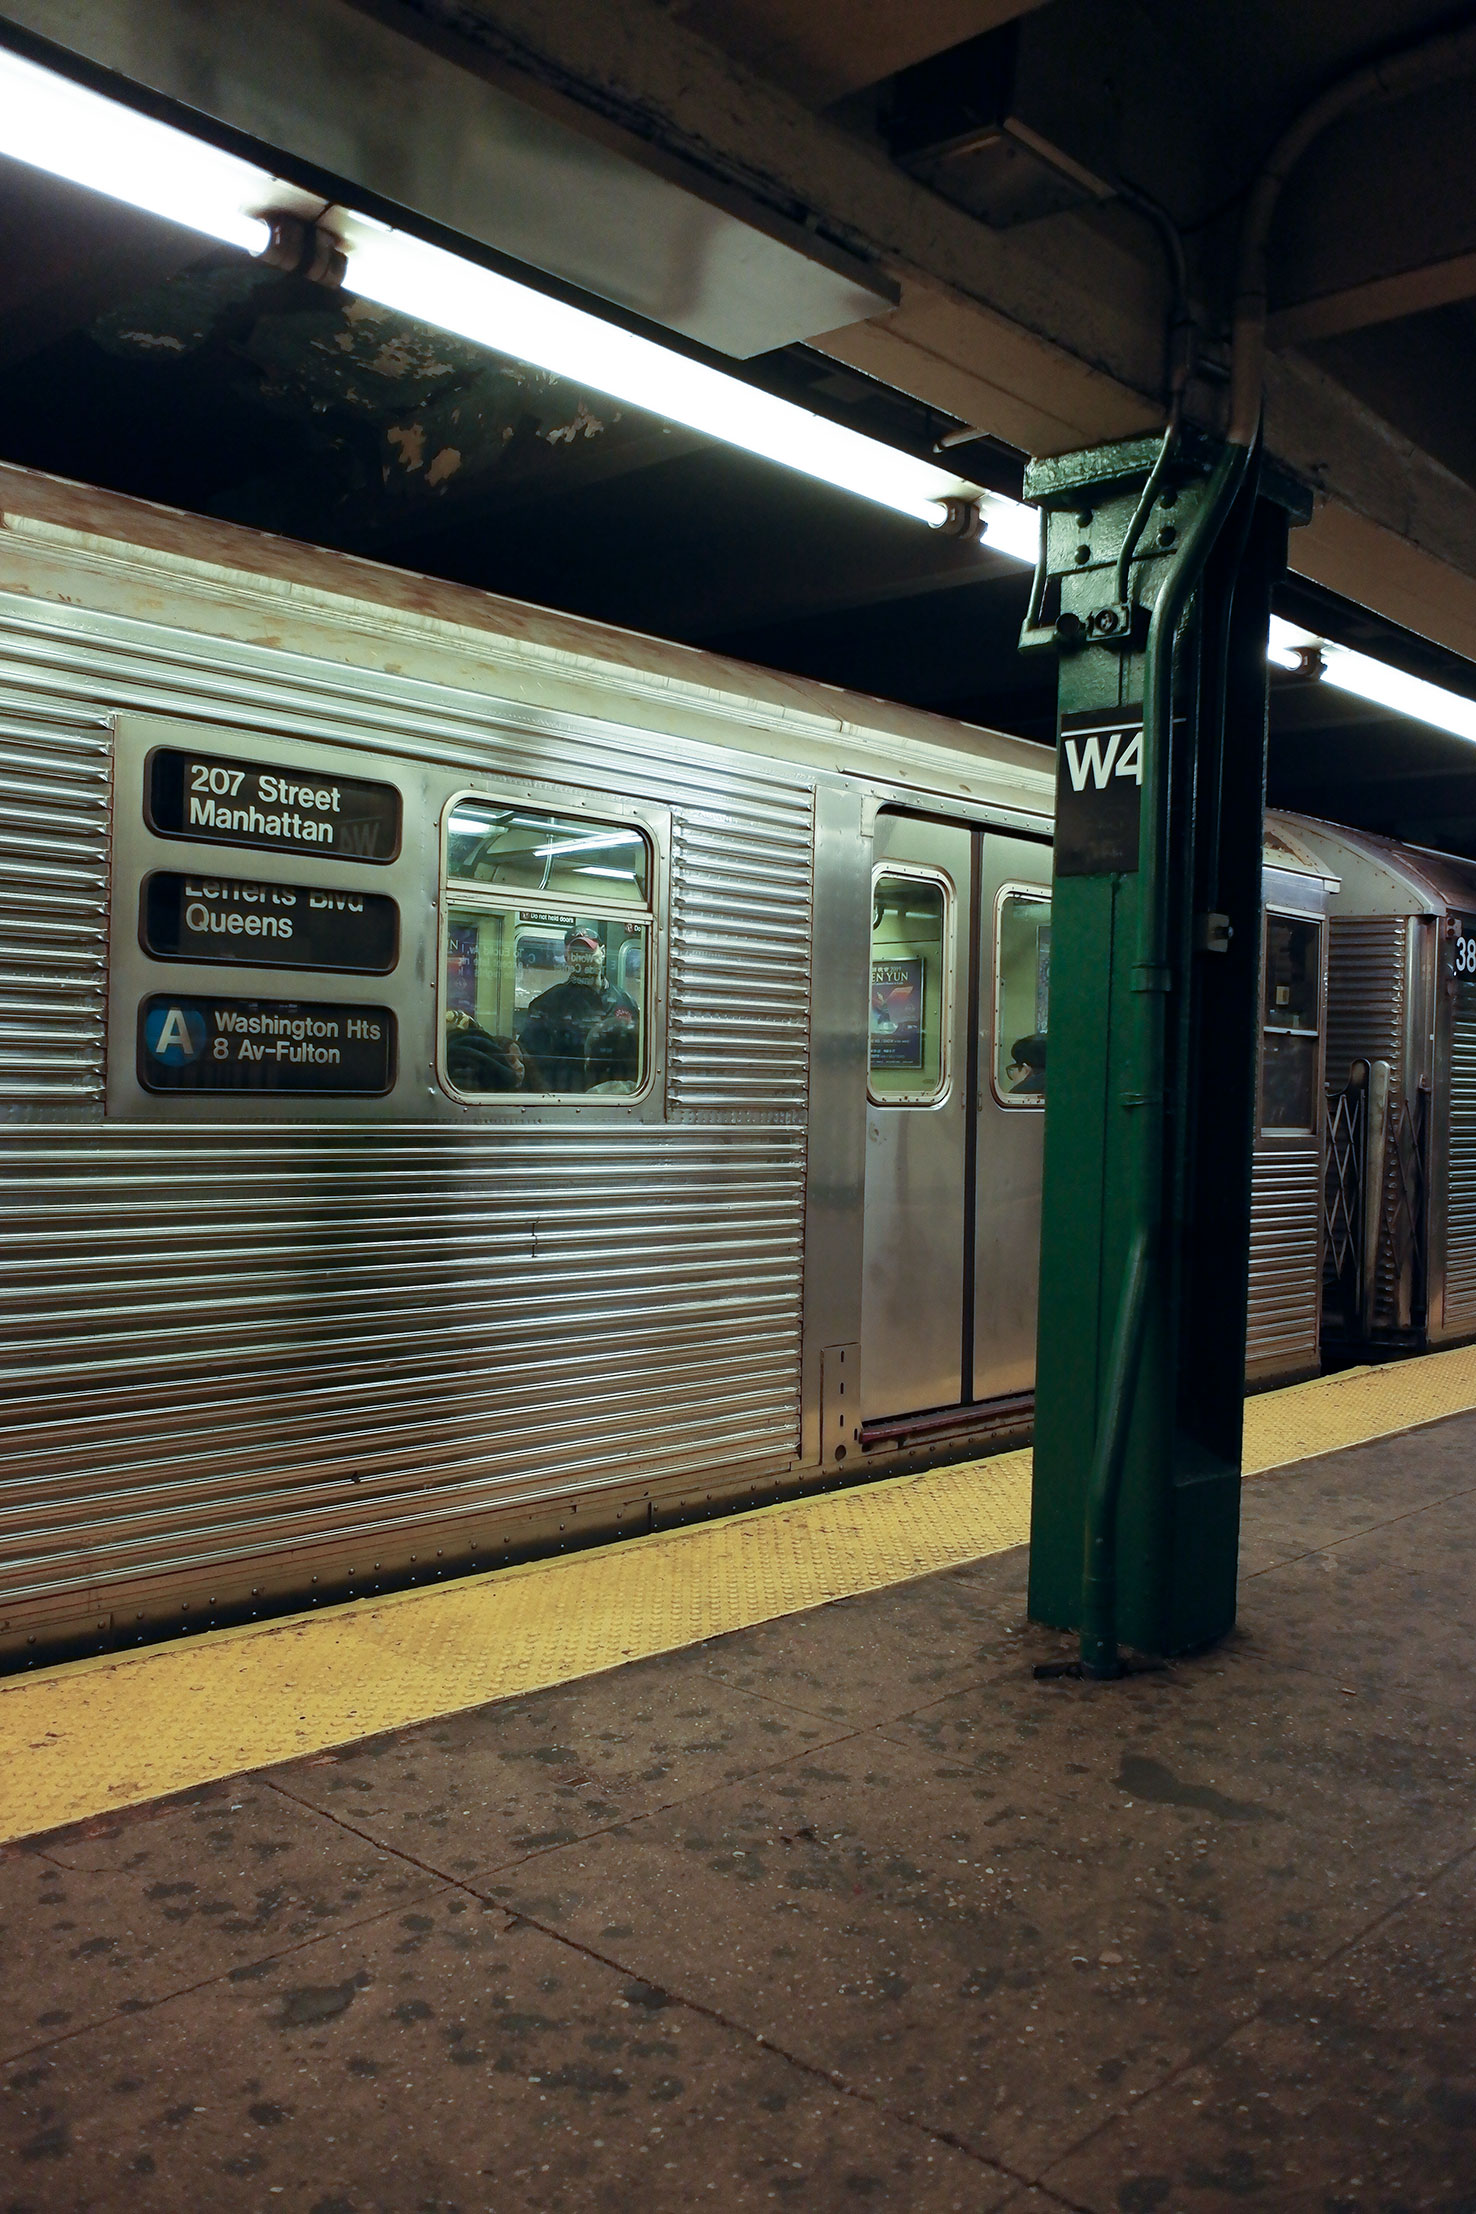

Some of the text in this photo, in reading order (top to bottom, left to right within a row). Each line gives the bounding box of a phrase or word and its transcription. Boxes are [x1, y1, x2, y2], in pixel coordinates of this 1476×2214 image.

[1064, 731, 1144, 792] W4
[190, 764, 341, 813] 207 Street
[189, 797, 334, 844] Manhattan
[185, 903, 294, 939] Queens
[1455, 937, 1476, 973] 38
[155, 1006, 194, 1055] A
[214, 1010, 381, 1041] Washington Hts
[213, 1037, 341, 1065] 8 Av-Fulton
